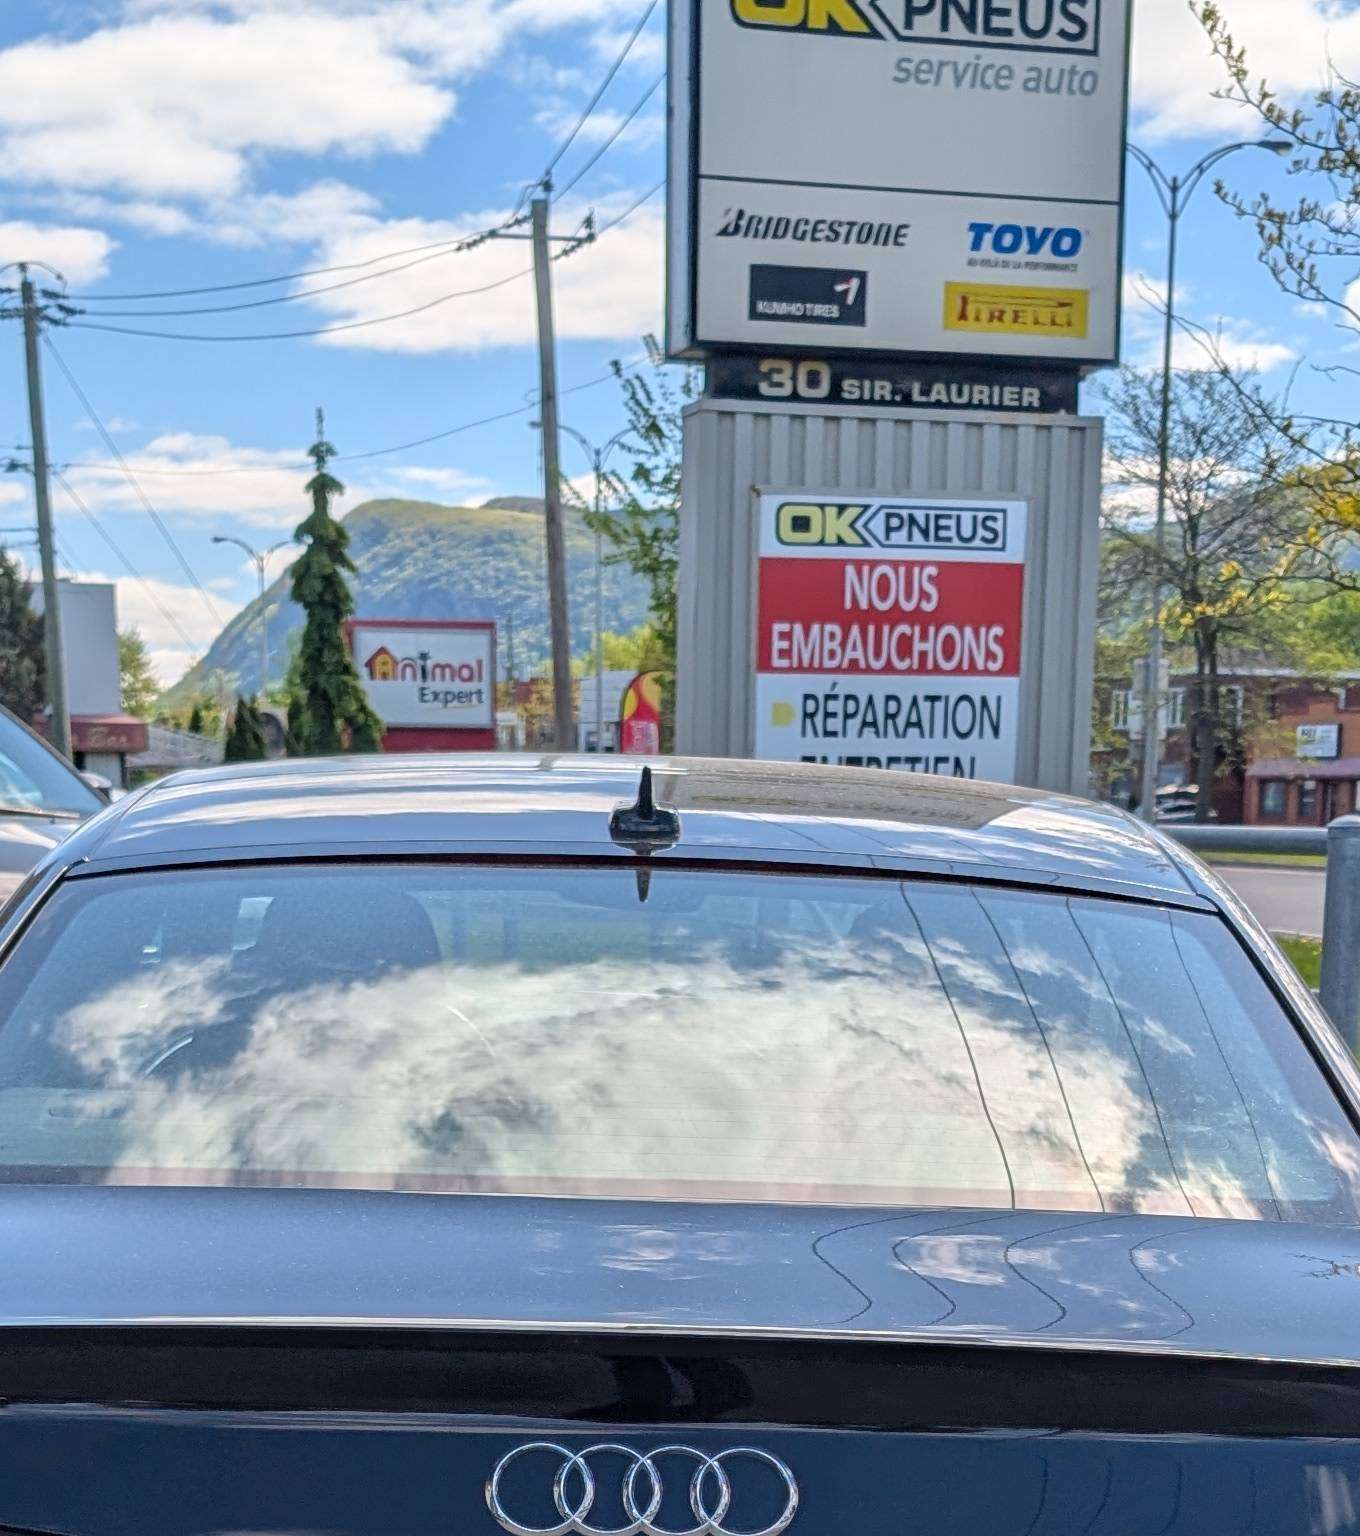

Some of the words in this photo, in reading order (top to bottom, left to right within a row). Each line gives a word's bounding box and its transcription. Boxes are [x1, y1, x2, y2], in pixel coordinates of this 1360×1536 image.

[902, 0, 1089, 42] PNEUS
[892, 54, 1013, 91] service
[1023, 62, 1099, 97] auto
[716, 207, 911, 247] BRIDGESTONE
[967, 221, 1083, 258] TOYO
[957, 293, 1074, 328] PIRELLI
[758, 358, 831, 398] 30
[841, 378, 902, 401] SIR.
[911, 382, 1040, 407] LAURIER
[778, 505, 868, 545] OK
[884, 512, 1000, 545] PNEUS
[844, 563, 939, 613] NOUS
[771, 621, 1004, 672] EMBAUCHONS
[419, 686, 484, 708] Expert
[801, 682, 1002, 740] RÉPARATION
